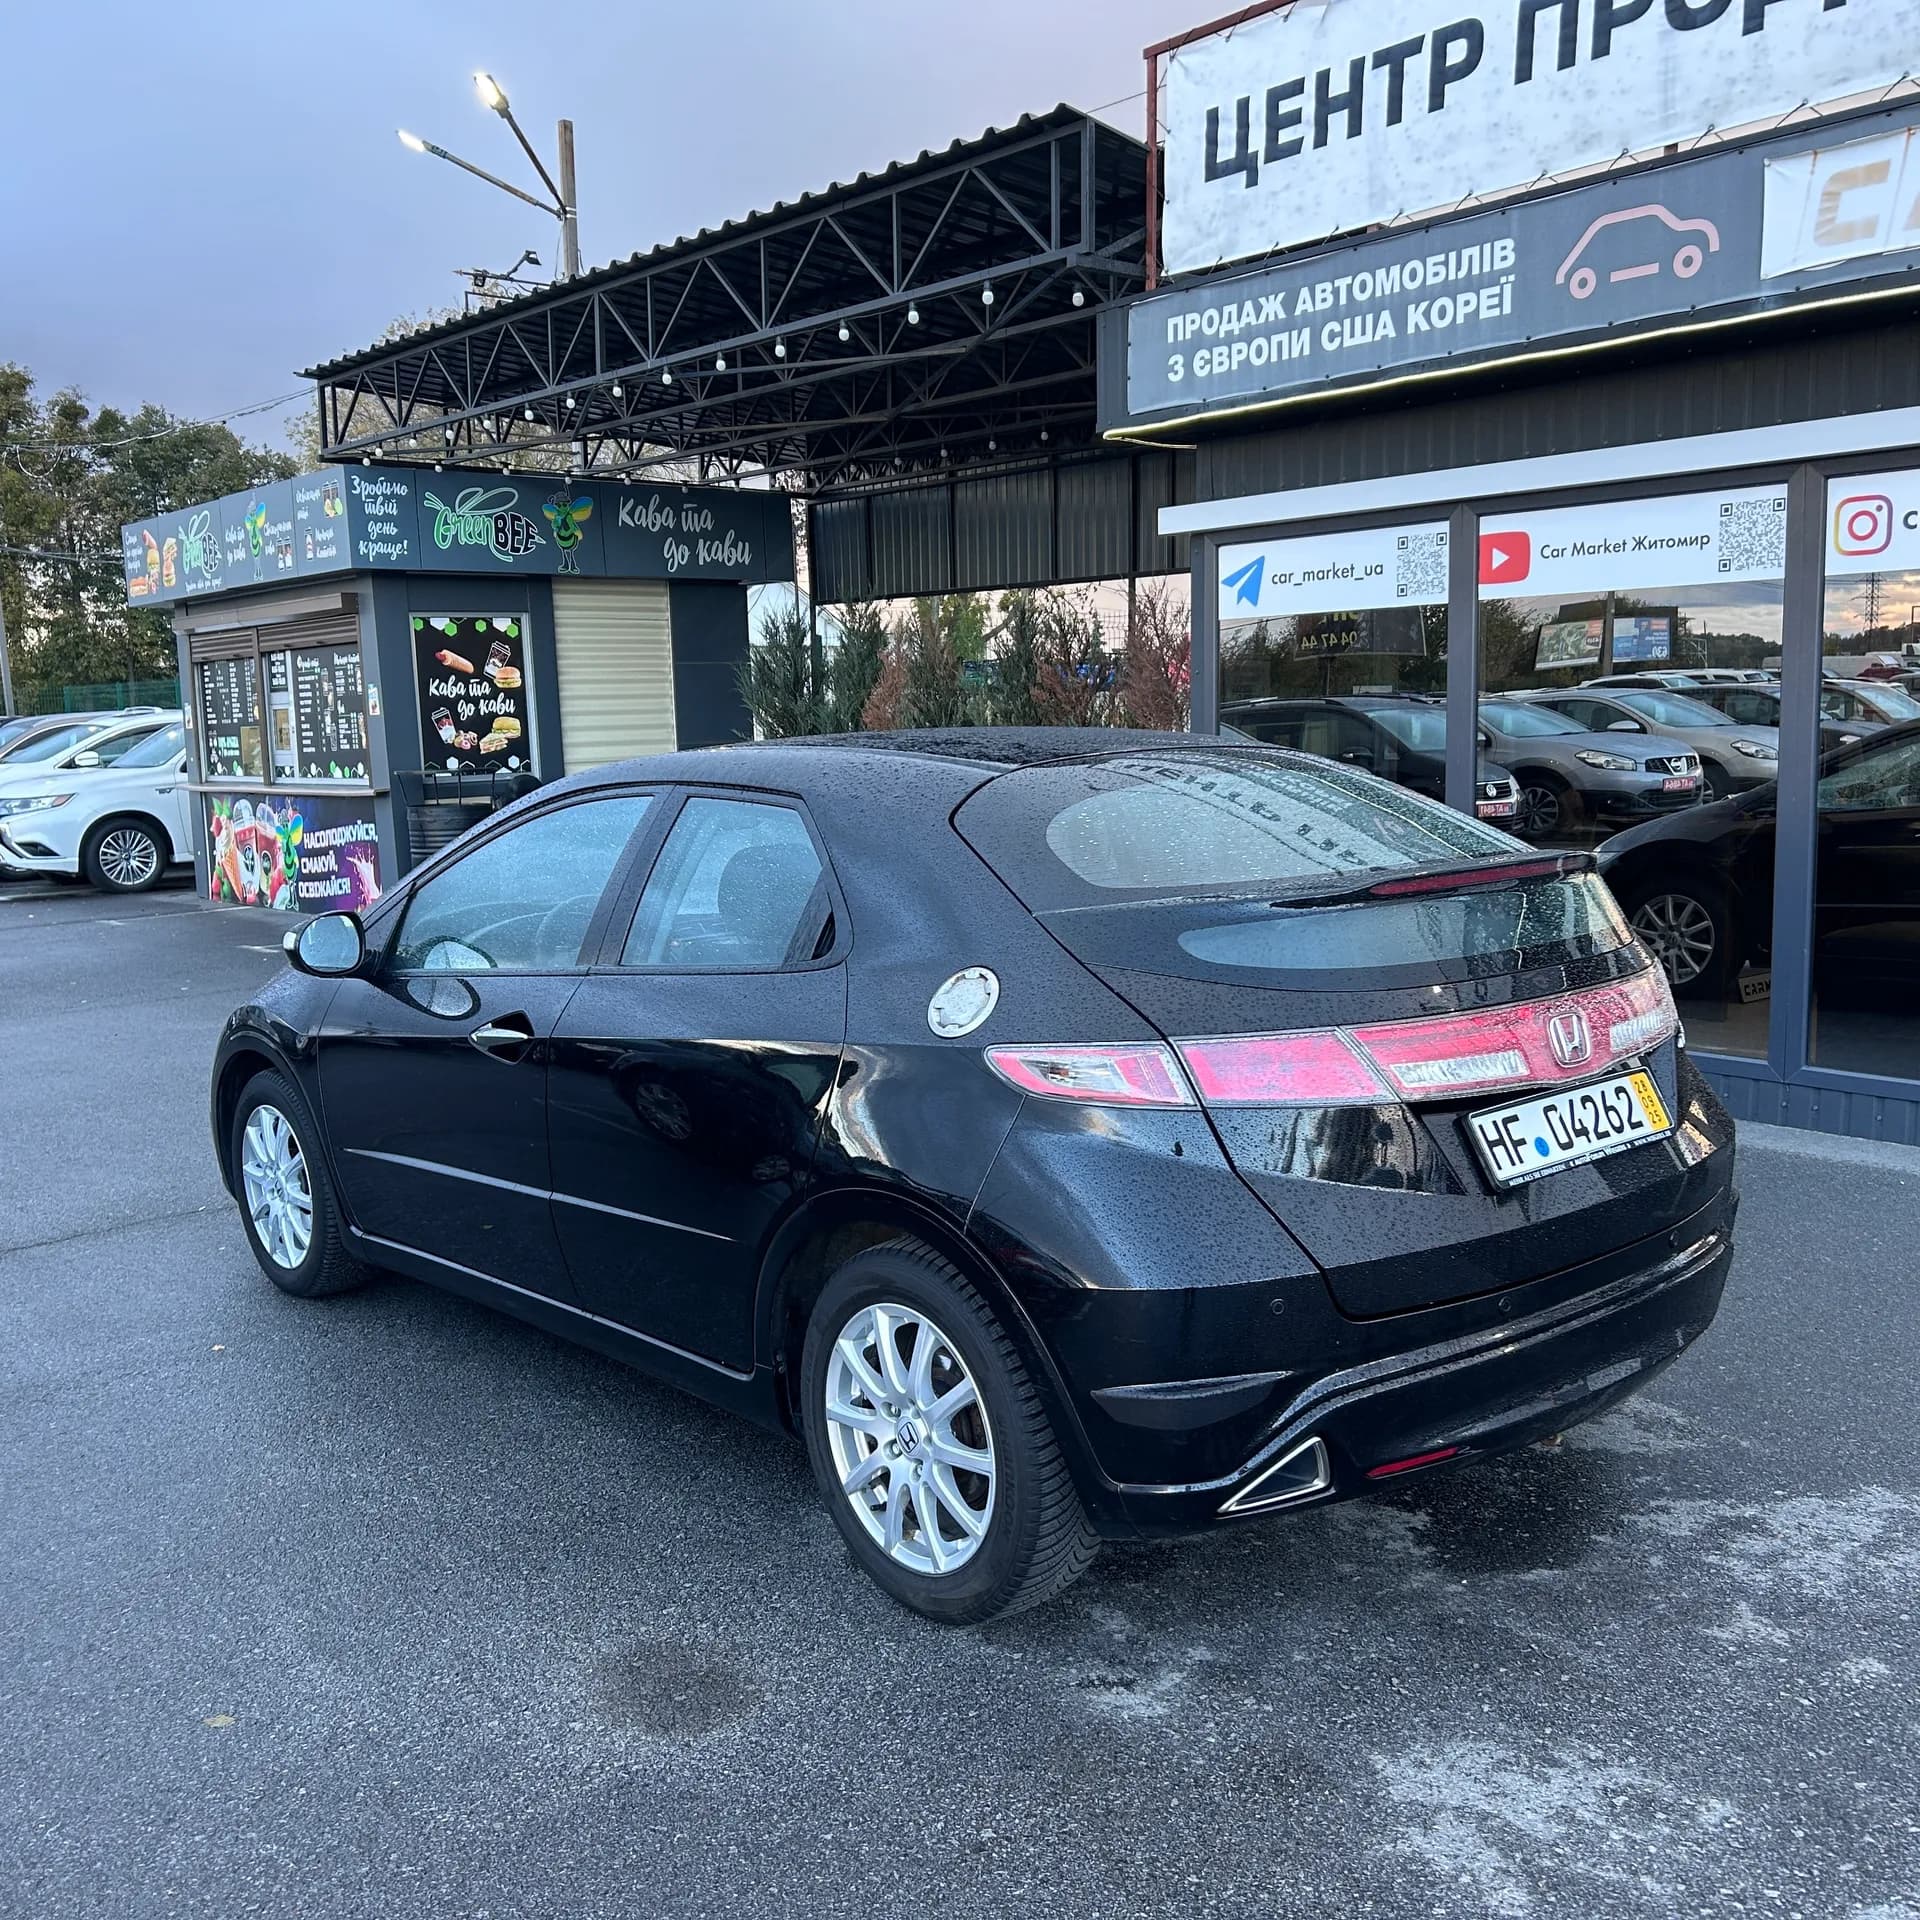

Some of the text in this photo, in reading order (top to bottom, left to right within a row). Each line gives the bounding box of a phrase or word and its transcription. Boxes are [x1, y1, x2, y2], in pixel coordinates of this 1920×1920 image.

[1204, 17, 1485, 188] ЦЕНТР
[1167, 238, 1516, 343] ПРОДАЖ АВТОМОБІЛІВ
[1167, 275, 1515, 382] З ЄВРОПИ США КОРЕЇ
[351, 475, 408, 501] Зробимо
[364, 495, 398, 516] твій
[618, 494, 715, 533] Кава та
[367, 521, 399, 540] день
[358, 539, 408, 562] краще!
[663, 529, 752, 573] до кави
[1540, 533, 1711, 560] Car Market Житомир
[1271, 561, 1384, 587] car_market_ua
[429, 675, 491, 698] Кава та
[458, 693, 516, 720] до кави
[303, 819, 378, 850] НАСОЛОДЖУЙСЯ,
[301, 850, 338, 875] СМАКУЙ,
[299, 875, 351, 899] ОСВІЖАЙСЯ!
[1478, 1085, 1643, 1171] HF 04262
